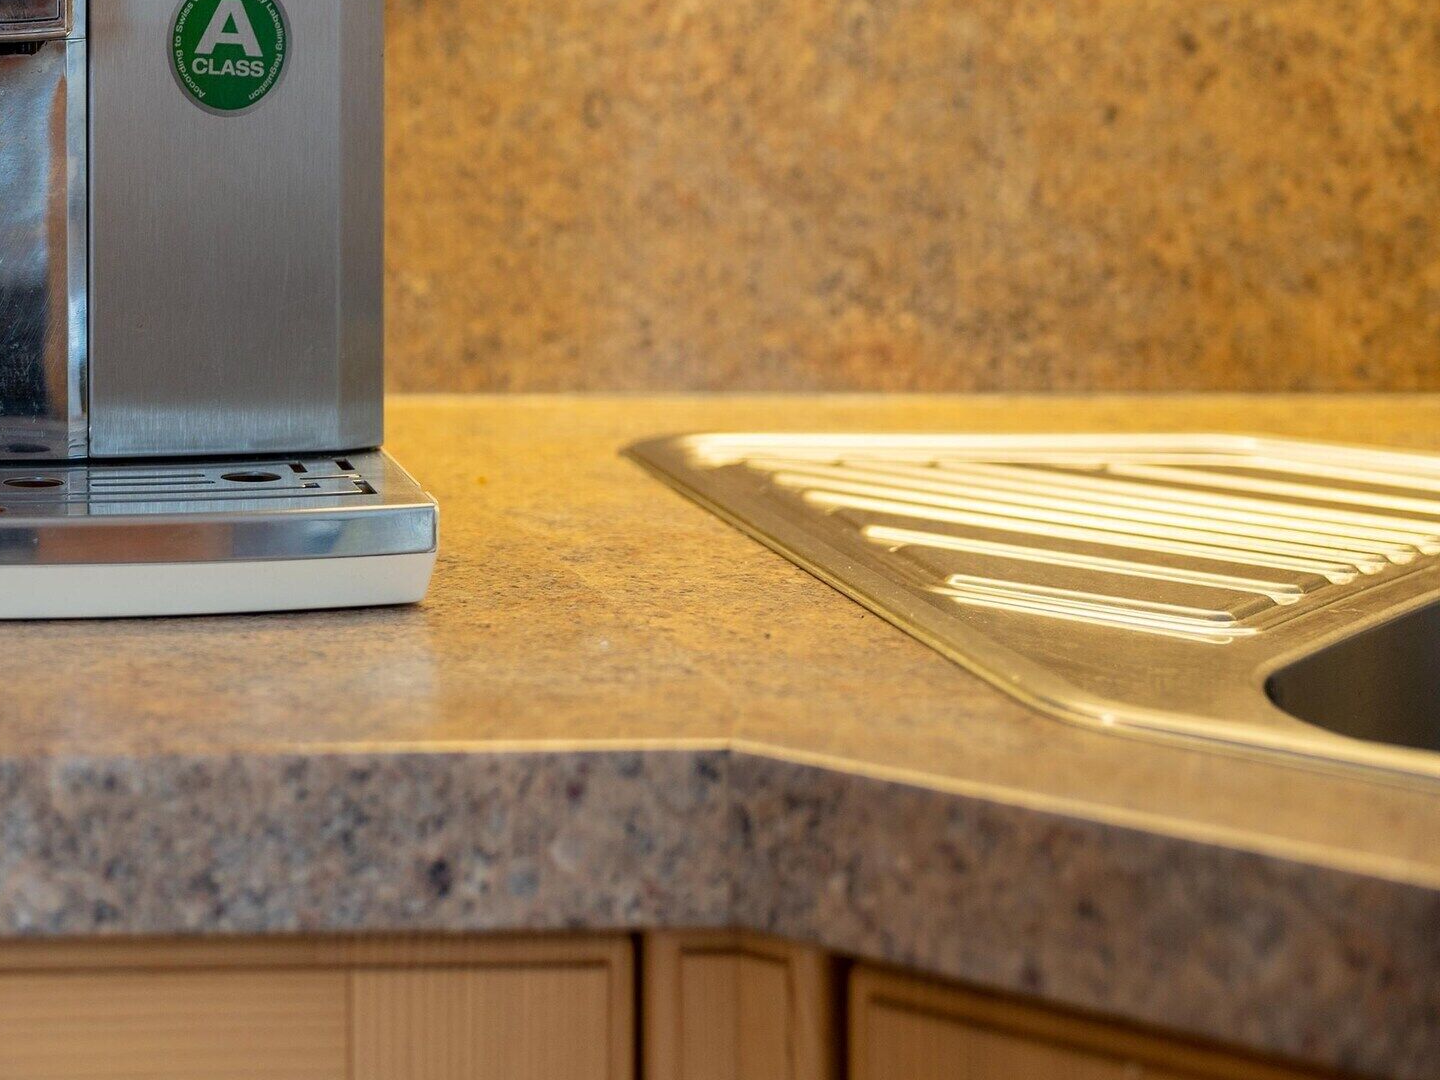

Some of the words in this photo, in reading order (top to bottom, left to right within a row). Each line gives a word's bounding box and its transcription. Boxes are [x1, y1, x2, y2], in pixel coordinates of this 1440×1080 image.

[176, 2, 194, 33] Swiss
[175, 35, 182, 47] to
[175, 49, 206, 98] According
[191, 57, 265, 78] CLASS
[248, 53, 283, 100] Regulation
